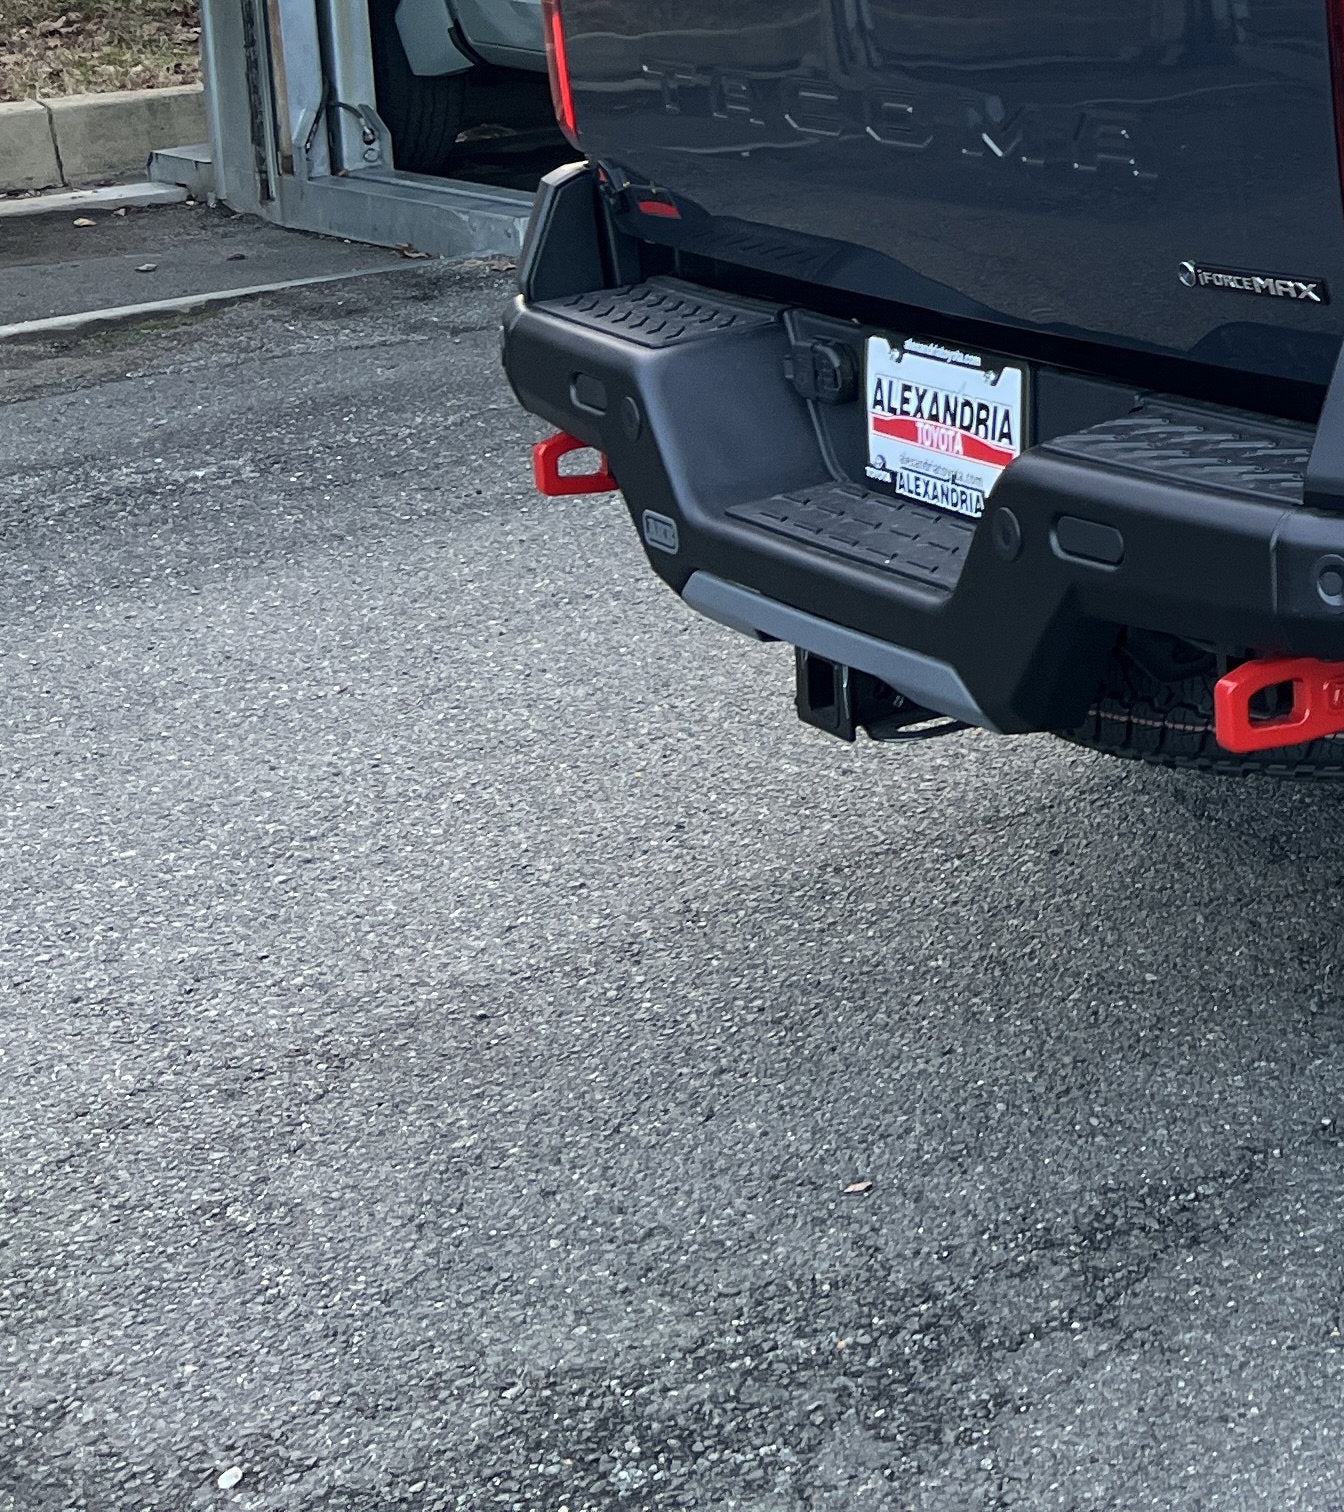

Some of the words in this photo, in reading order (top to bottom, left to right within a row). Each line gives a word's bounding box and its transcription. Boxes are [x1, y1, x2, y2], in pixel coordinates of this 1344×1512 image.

[872, 376, 1013, 446] ALEXANDRIA
[915, 420, 964, 456] TOYOTA
[898, 471, 983, 515] ALEXANDRIA
